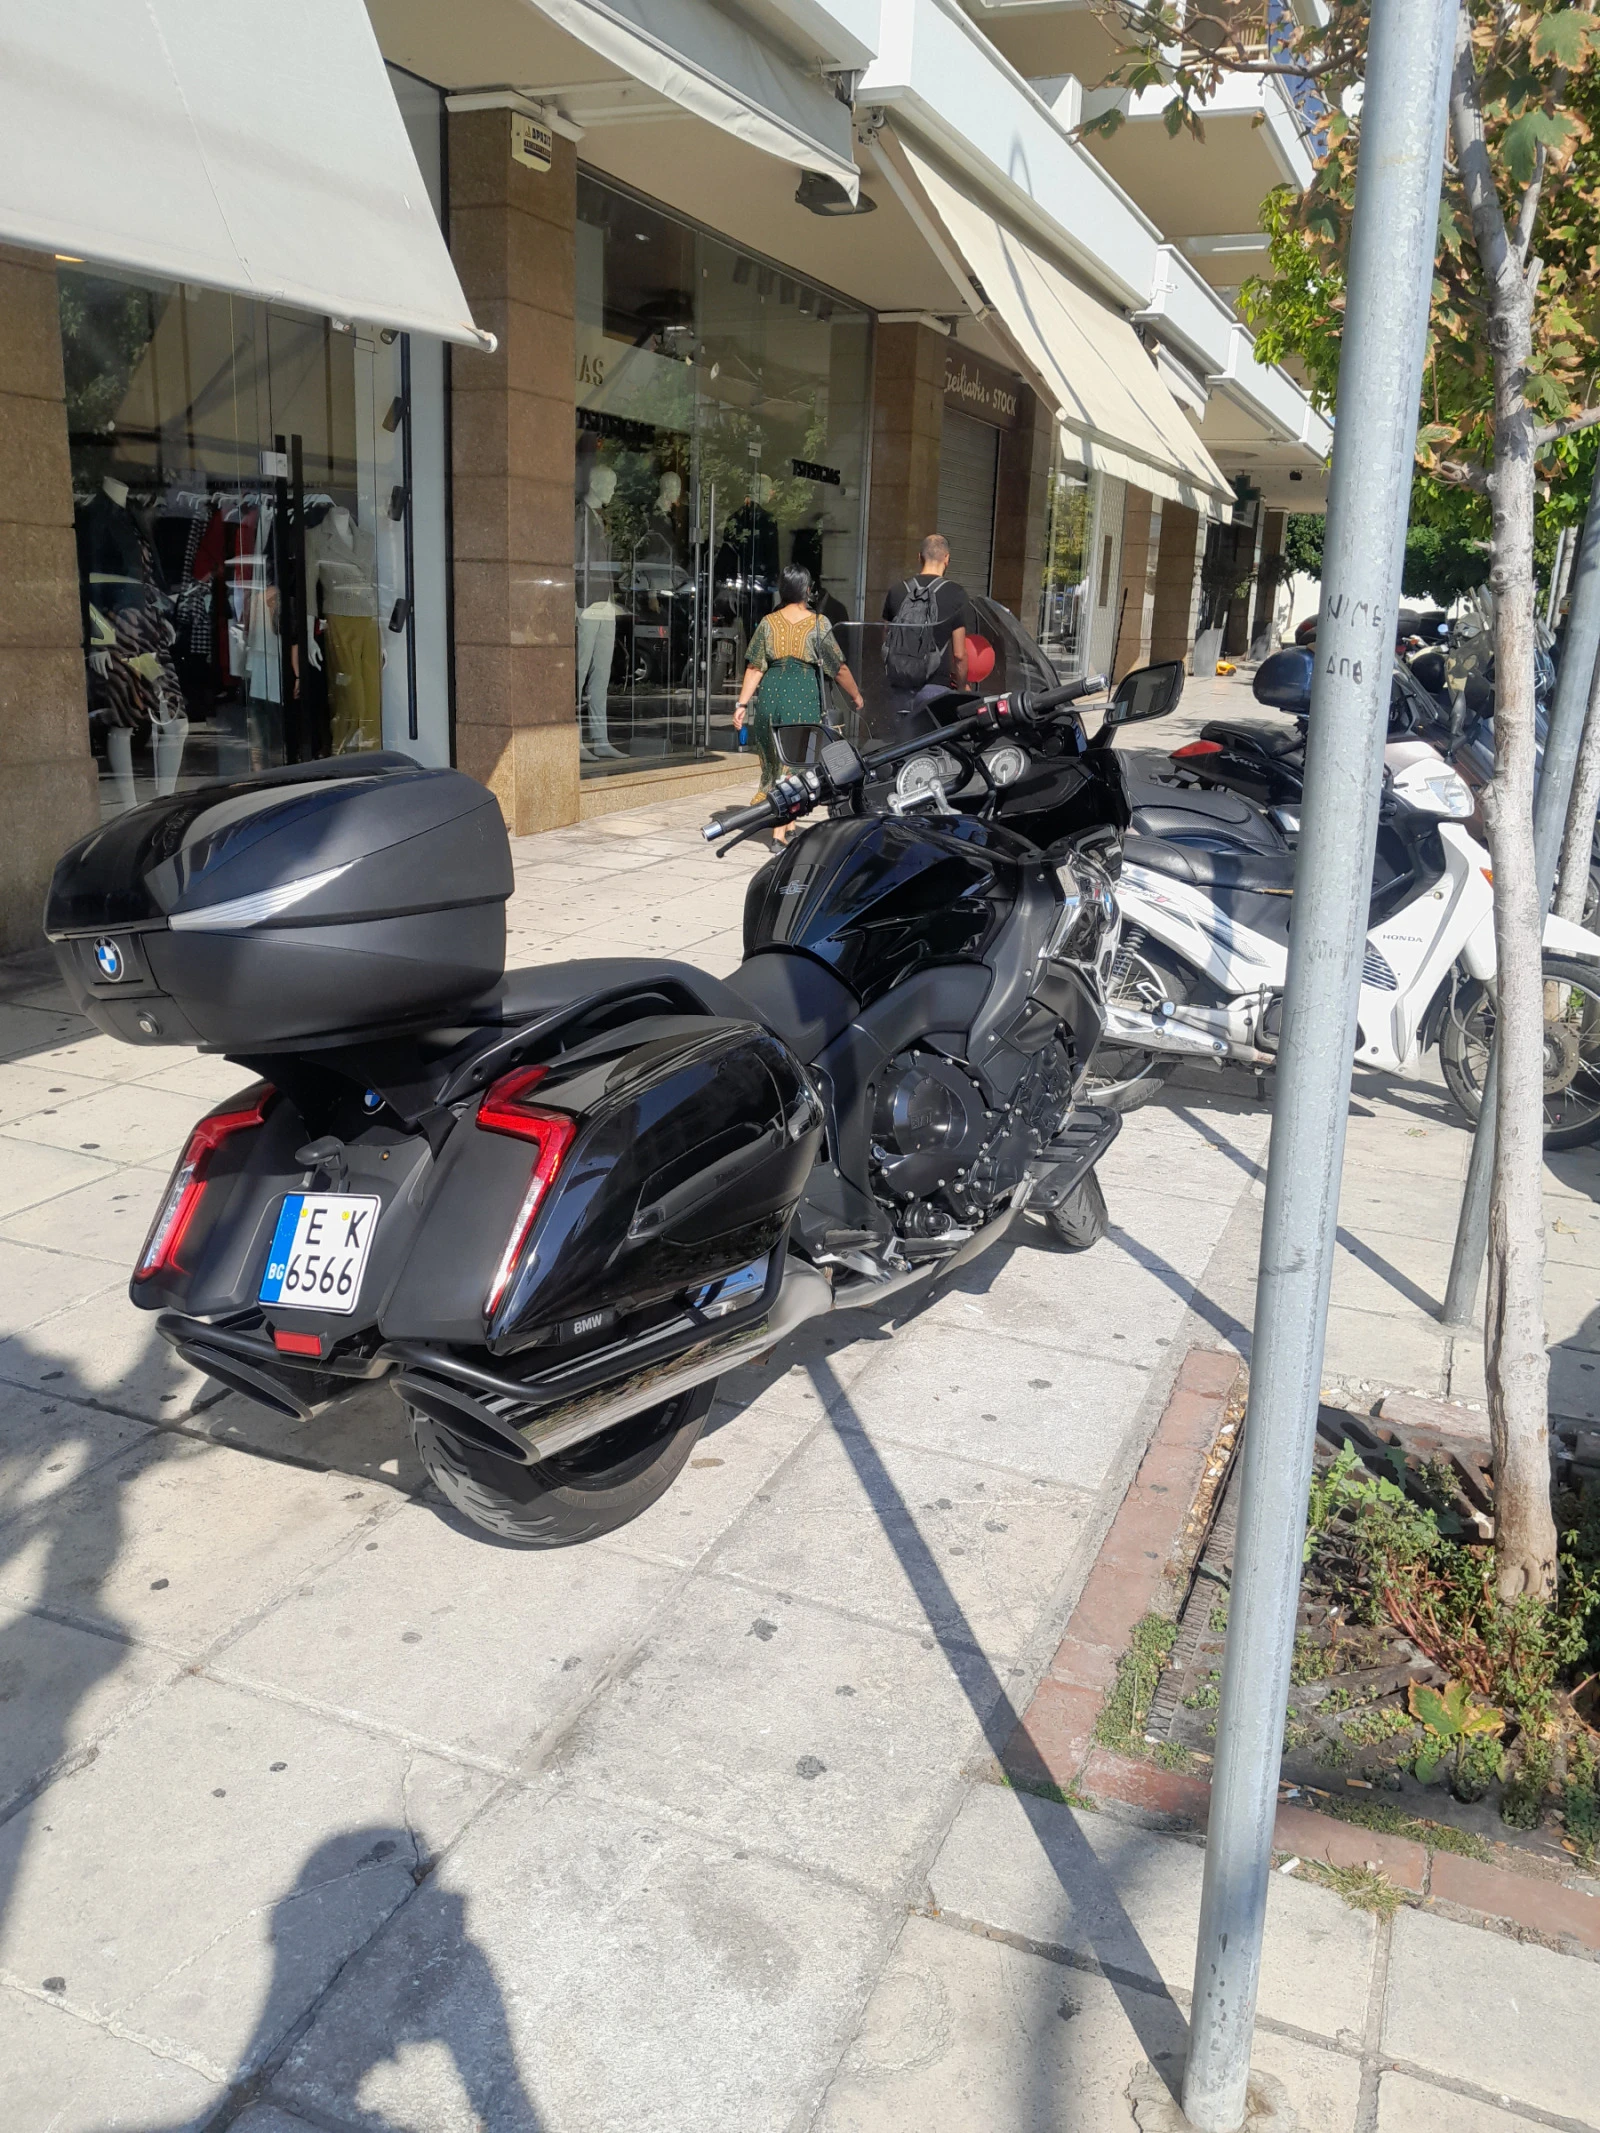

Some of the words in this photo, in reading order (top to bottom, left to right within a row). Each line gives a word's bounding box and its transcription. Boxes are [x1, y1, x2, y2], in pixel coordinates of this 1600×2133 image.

[992, 388, 1017, 416] STOCK
[1382, 934, 1424, 943] HONDA
[305, 1208, 328, 1245] E
[344, 1210, 368, 1248] K
[267, 1262, 286, 1281] BG
[285, 1254, 354, 1296] 6566
[573, 1313, 603, 1335] BMW
